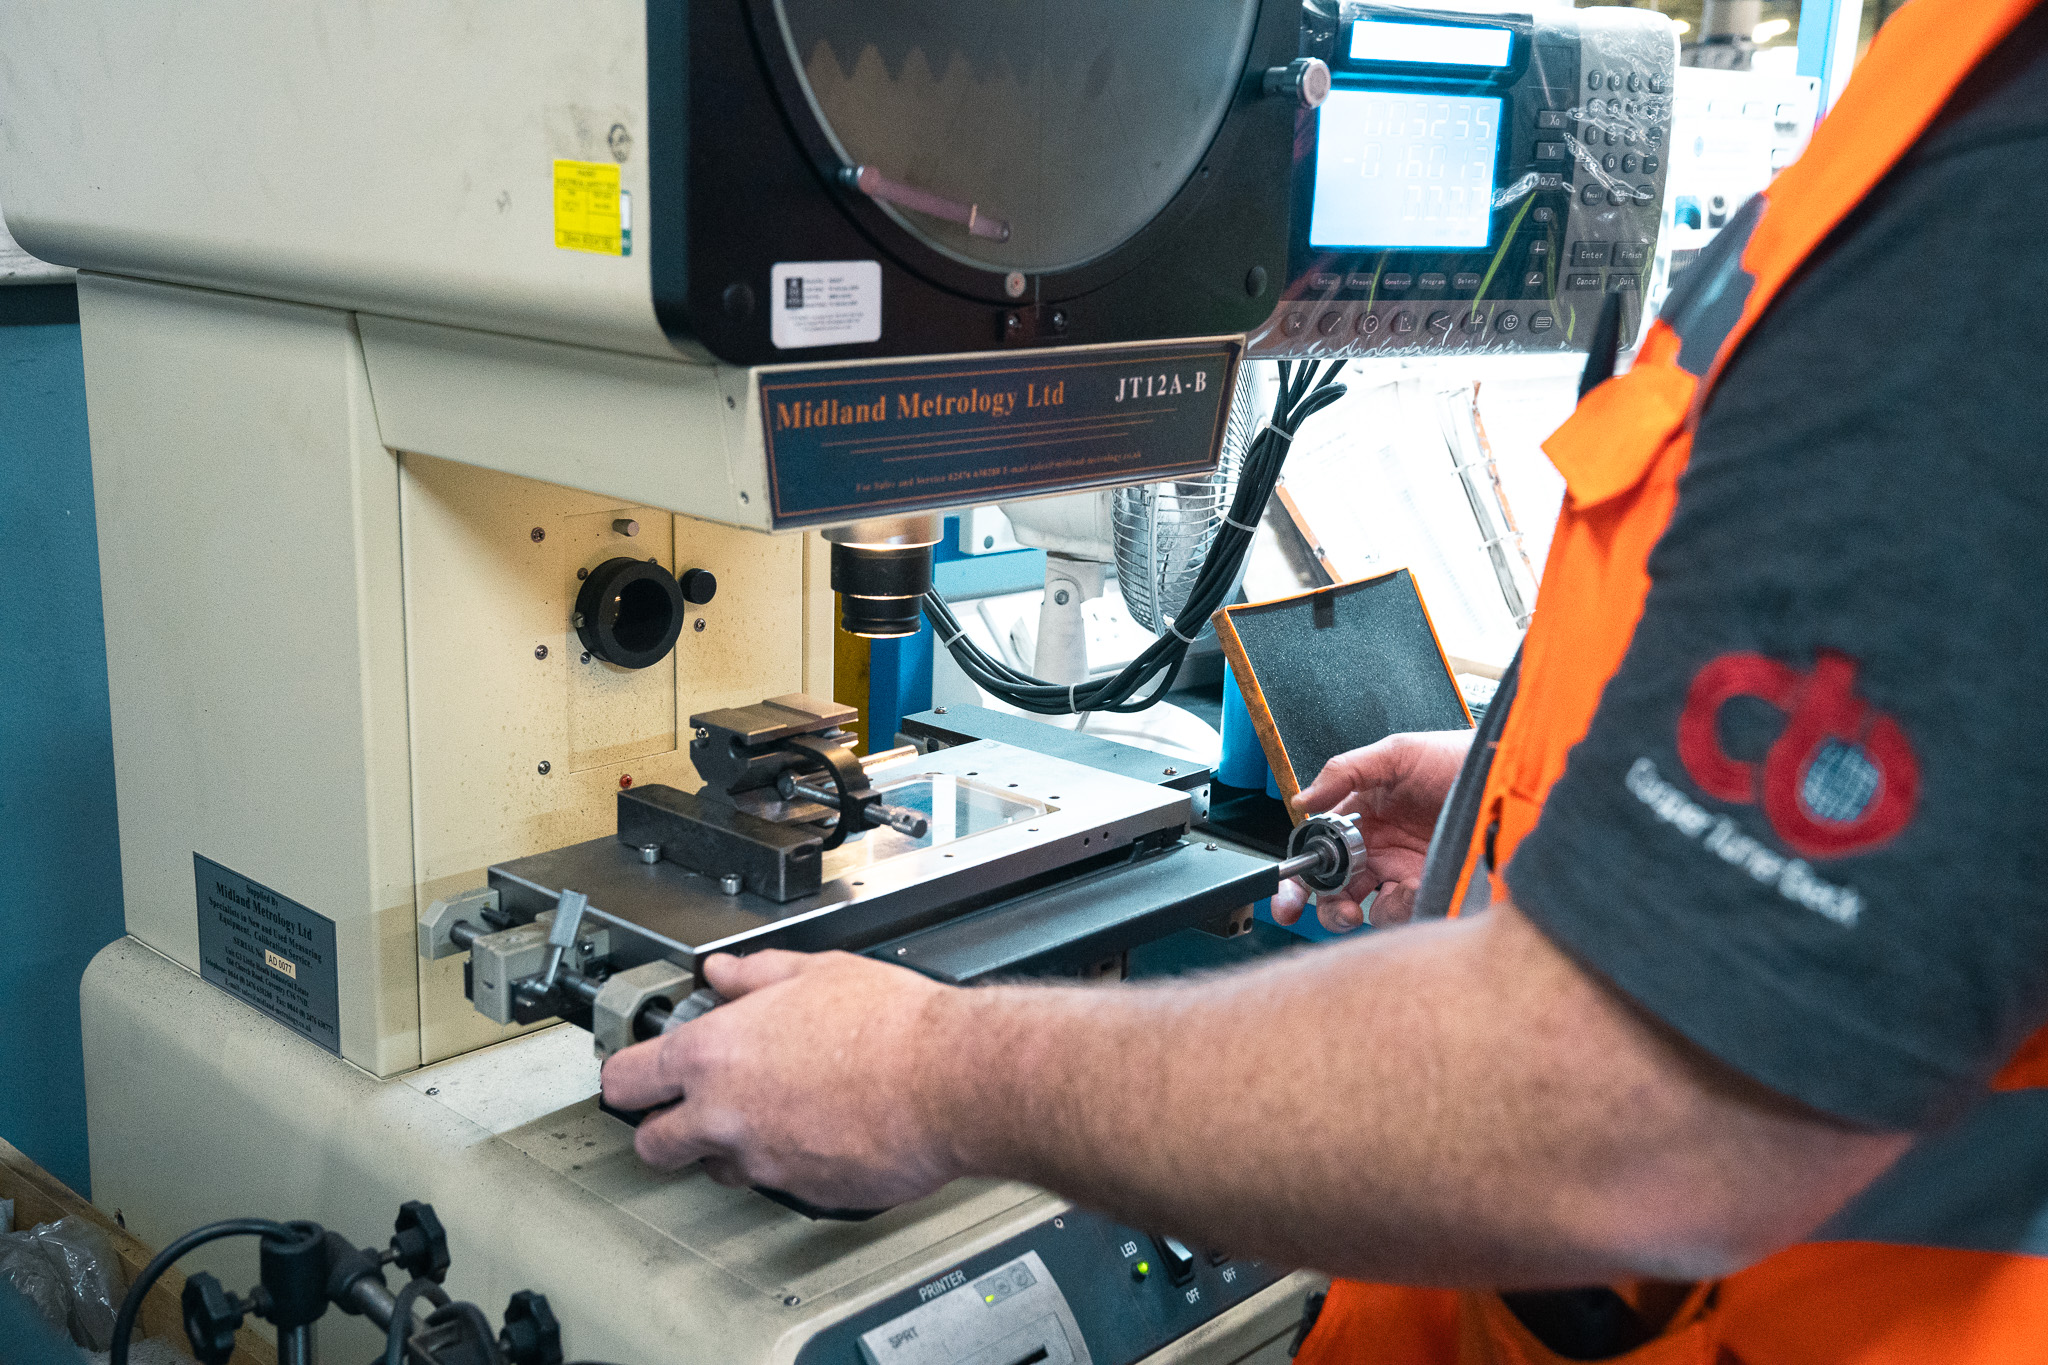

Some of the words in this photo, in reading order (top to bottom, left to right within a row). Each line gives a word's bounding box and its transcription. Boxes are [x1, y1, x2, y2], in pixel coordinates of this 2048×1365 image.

[1595, 74, 1600, 85] 7
[1614, 75, 1620, 86] 8
[1634, 76, 1639, 87] 9
[1608, 157, 1615, 168] 0
[1581, 251, 1604, 259] Enter
[1621, 251, 1642, 259] Finish
[1352, 278, 1373, 286] Preset
[1385, 278, 1411, 286] Construct
[1421, 278, 1445, 287] Program
[1458, 277, 1478, 285] Delete
[1576, 277, 1600, 286] Cancel
[1619, 277, 1635, 286] Quit
[1115, 371, 1207, 403] JT12A-B
[777, 395, 887, 431] Midland
[897, 388, 1017, 420] Metrology
[1027, 381, 1064, 408] Ltd
[247, 885, 269, 904] Supplied
[271, 897, 278, 909] By
[217, 881, 250, 910] Midland
[253, 900, 295, 935] Metrology
[298, 923, 312, 942] Ltd
[209, 896, 239, 918] Specialists
[241, 914, 246, 922] in
[249, 917, 259, 929] New
[262, 924, 271, 935] and
[274, 929, 287, 944] Used
[290, 938, 321, 963] Measuring
[255, 932, 286, 955] Calibration
[233, 936, 253, 954] SERIAL
[268, 954, 277, 966] AD
[278, 960, 292, 974] 0077
[1120, 1240, 1138, 1258] LED
[1222, 1267, 1237, 1284] OFF
[918, 1269, 968, 1303] PRINTER
[1185, 1287, 1200, 1304] OFF
